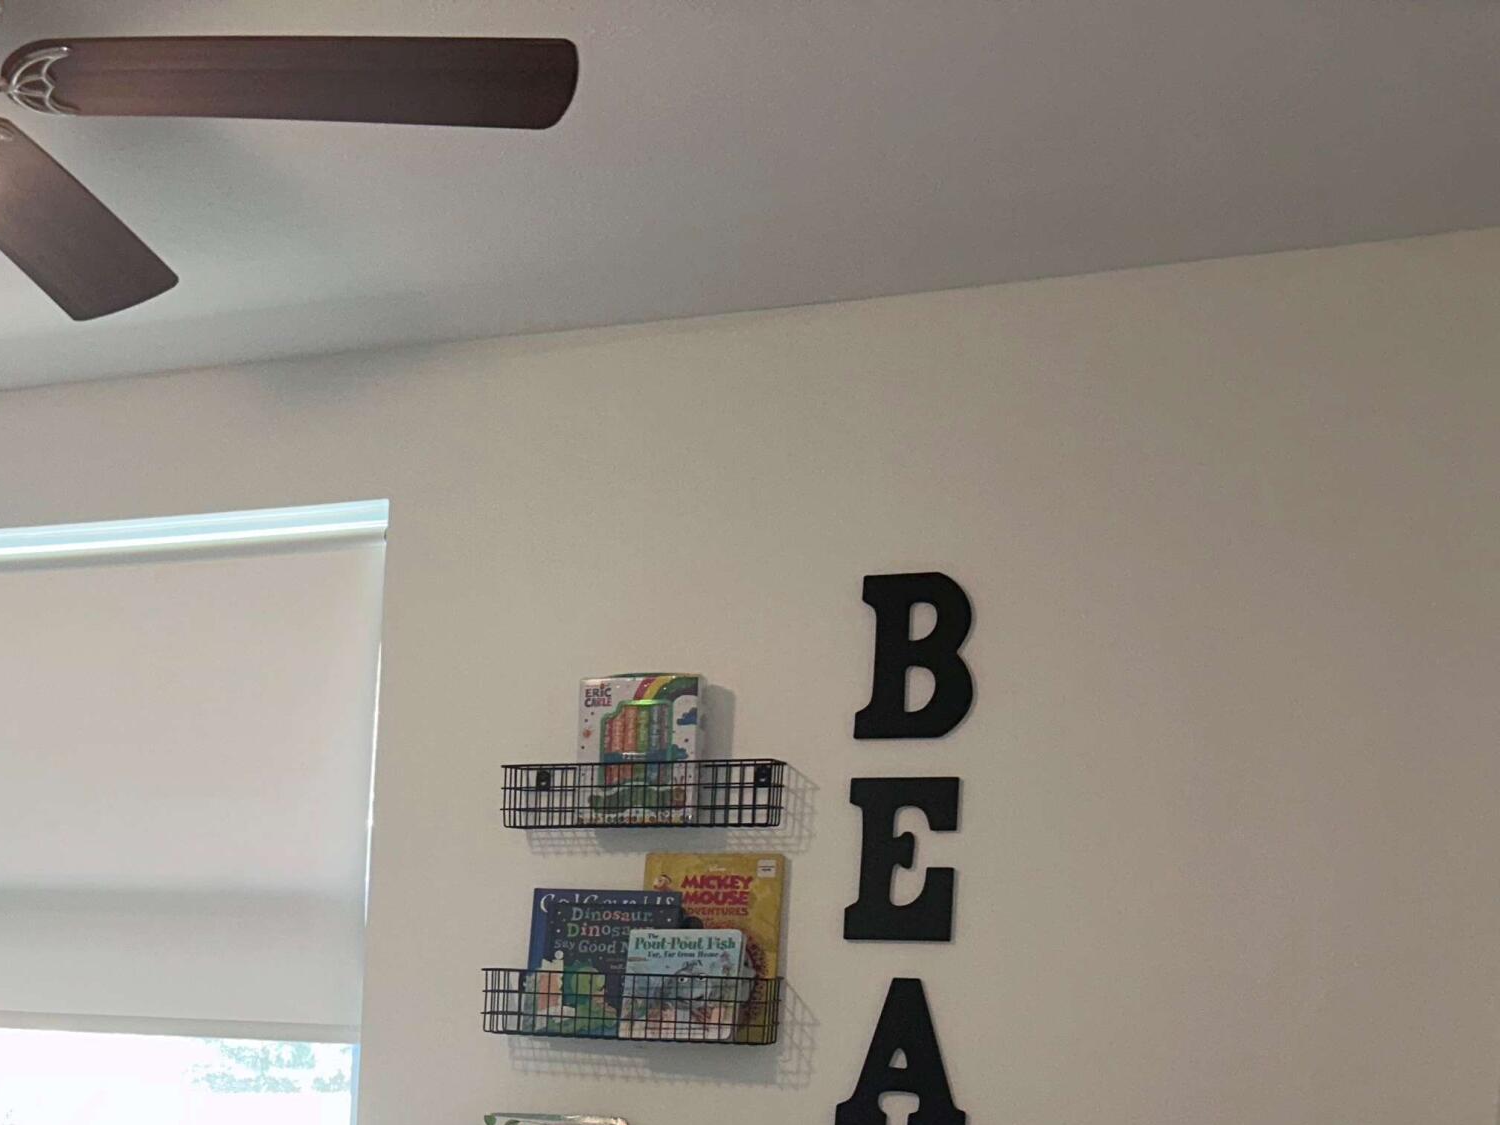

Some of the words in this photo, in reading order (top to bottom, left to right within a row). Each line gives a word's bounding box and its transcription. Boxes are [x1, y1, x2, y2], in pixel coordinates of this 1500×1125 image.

[585, 687, 612, 698] ERIC
[681, 875, 753, 889] MICKEY
[682, 891, 749, 905] MOUSE
[567, 922, 652, 937] Dinosa
[578, 940, 617, 954] Good
[635, 937, 704, 950] Pout-Pout
[707, 937, 736, 950] Fish
